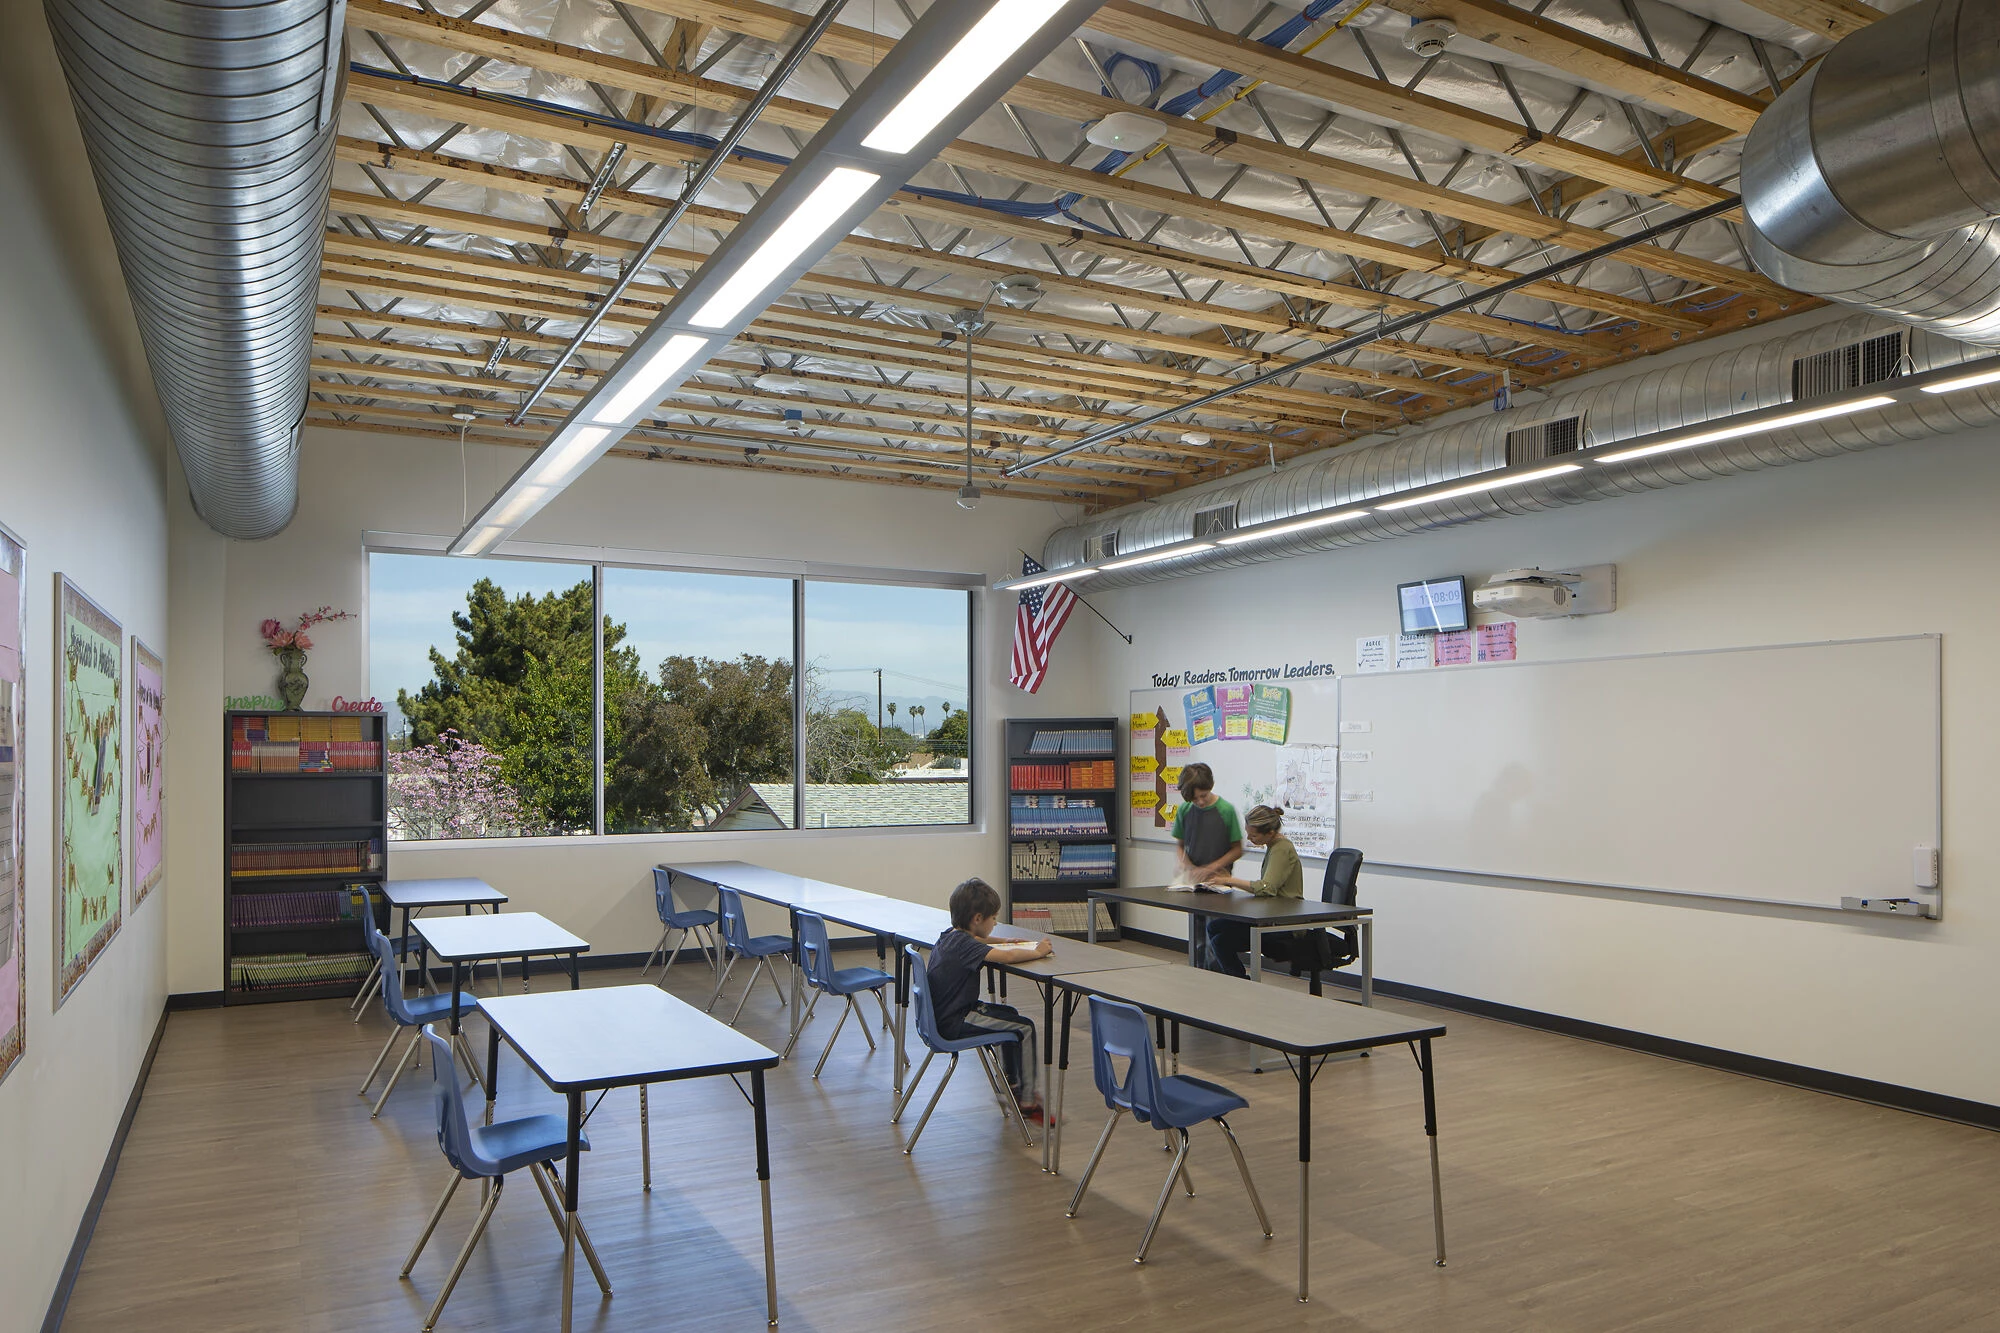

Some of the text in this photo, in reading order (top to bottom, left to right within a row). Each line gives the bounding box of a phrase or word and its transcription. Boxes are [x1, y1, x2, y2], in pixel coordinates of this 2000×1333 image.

[1152, 660, 1335, 688] Today Readers. Tomorrow Leaders.
[223, 695, 286, 711] Inspire
[331, 695, 384, 712] Create
